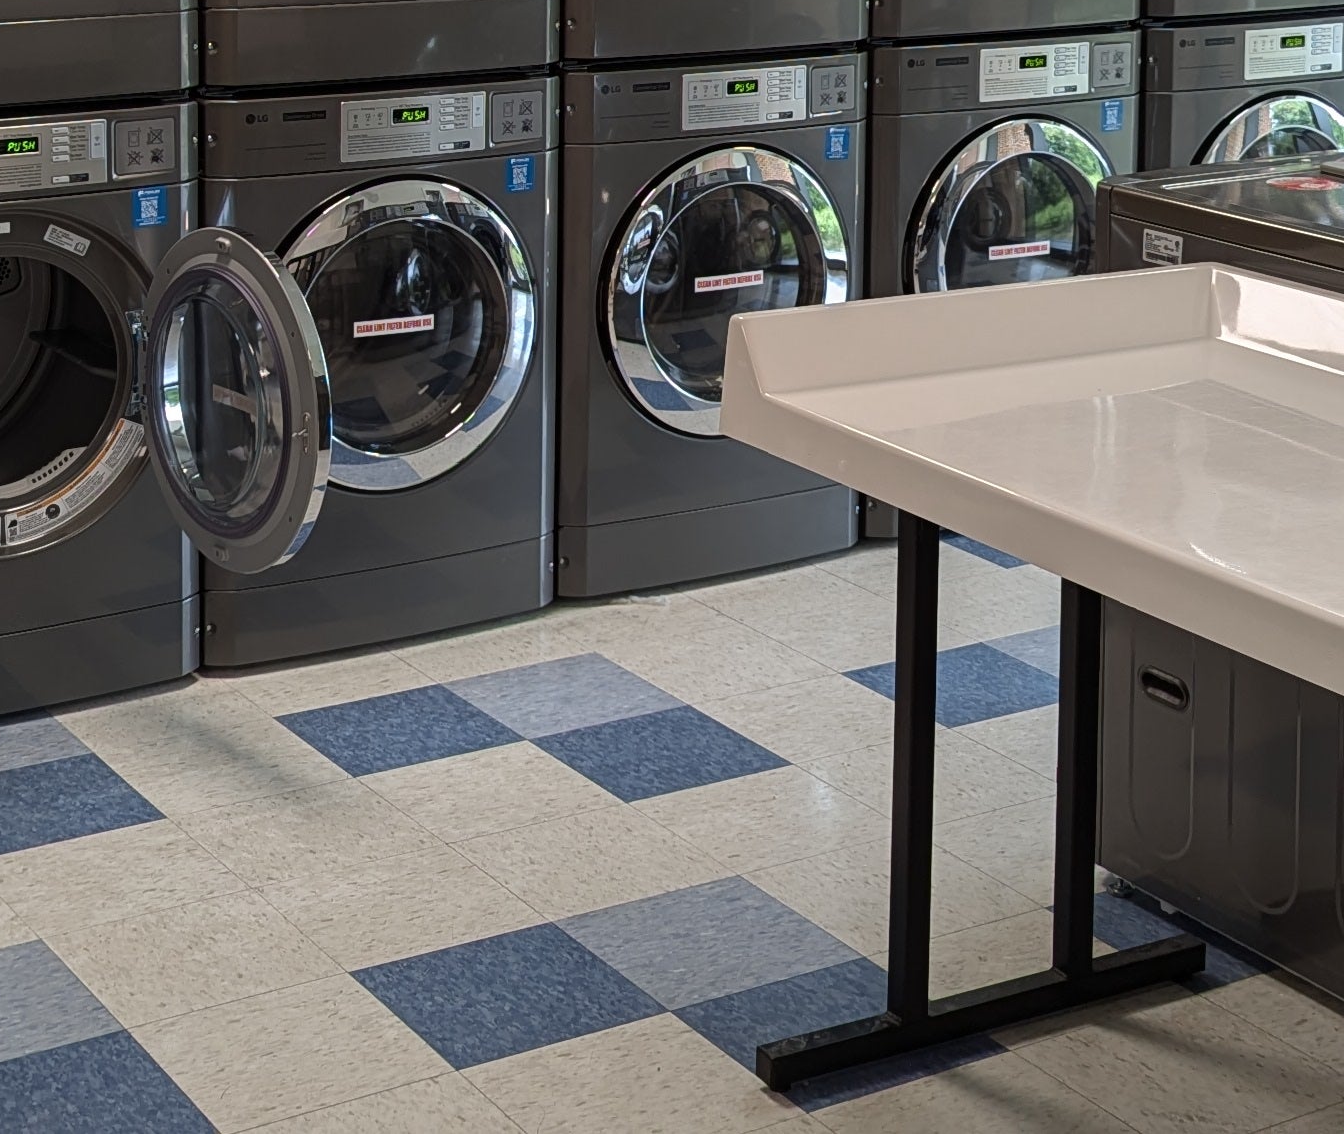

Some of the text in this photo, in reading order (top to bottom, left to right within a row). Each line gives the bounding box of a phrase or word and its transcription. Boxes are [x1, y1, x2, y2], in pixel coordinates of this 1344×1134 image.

[257, 115, 269, 123] LG
[402, 111, 426, 122] PUSH
[8, 140, 36, 152] PUSH
